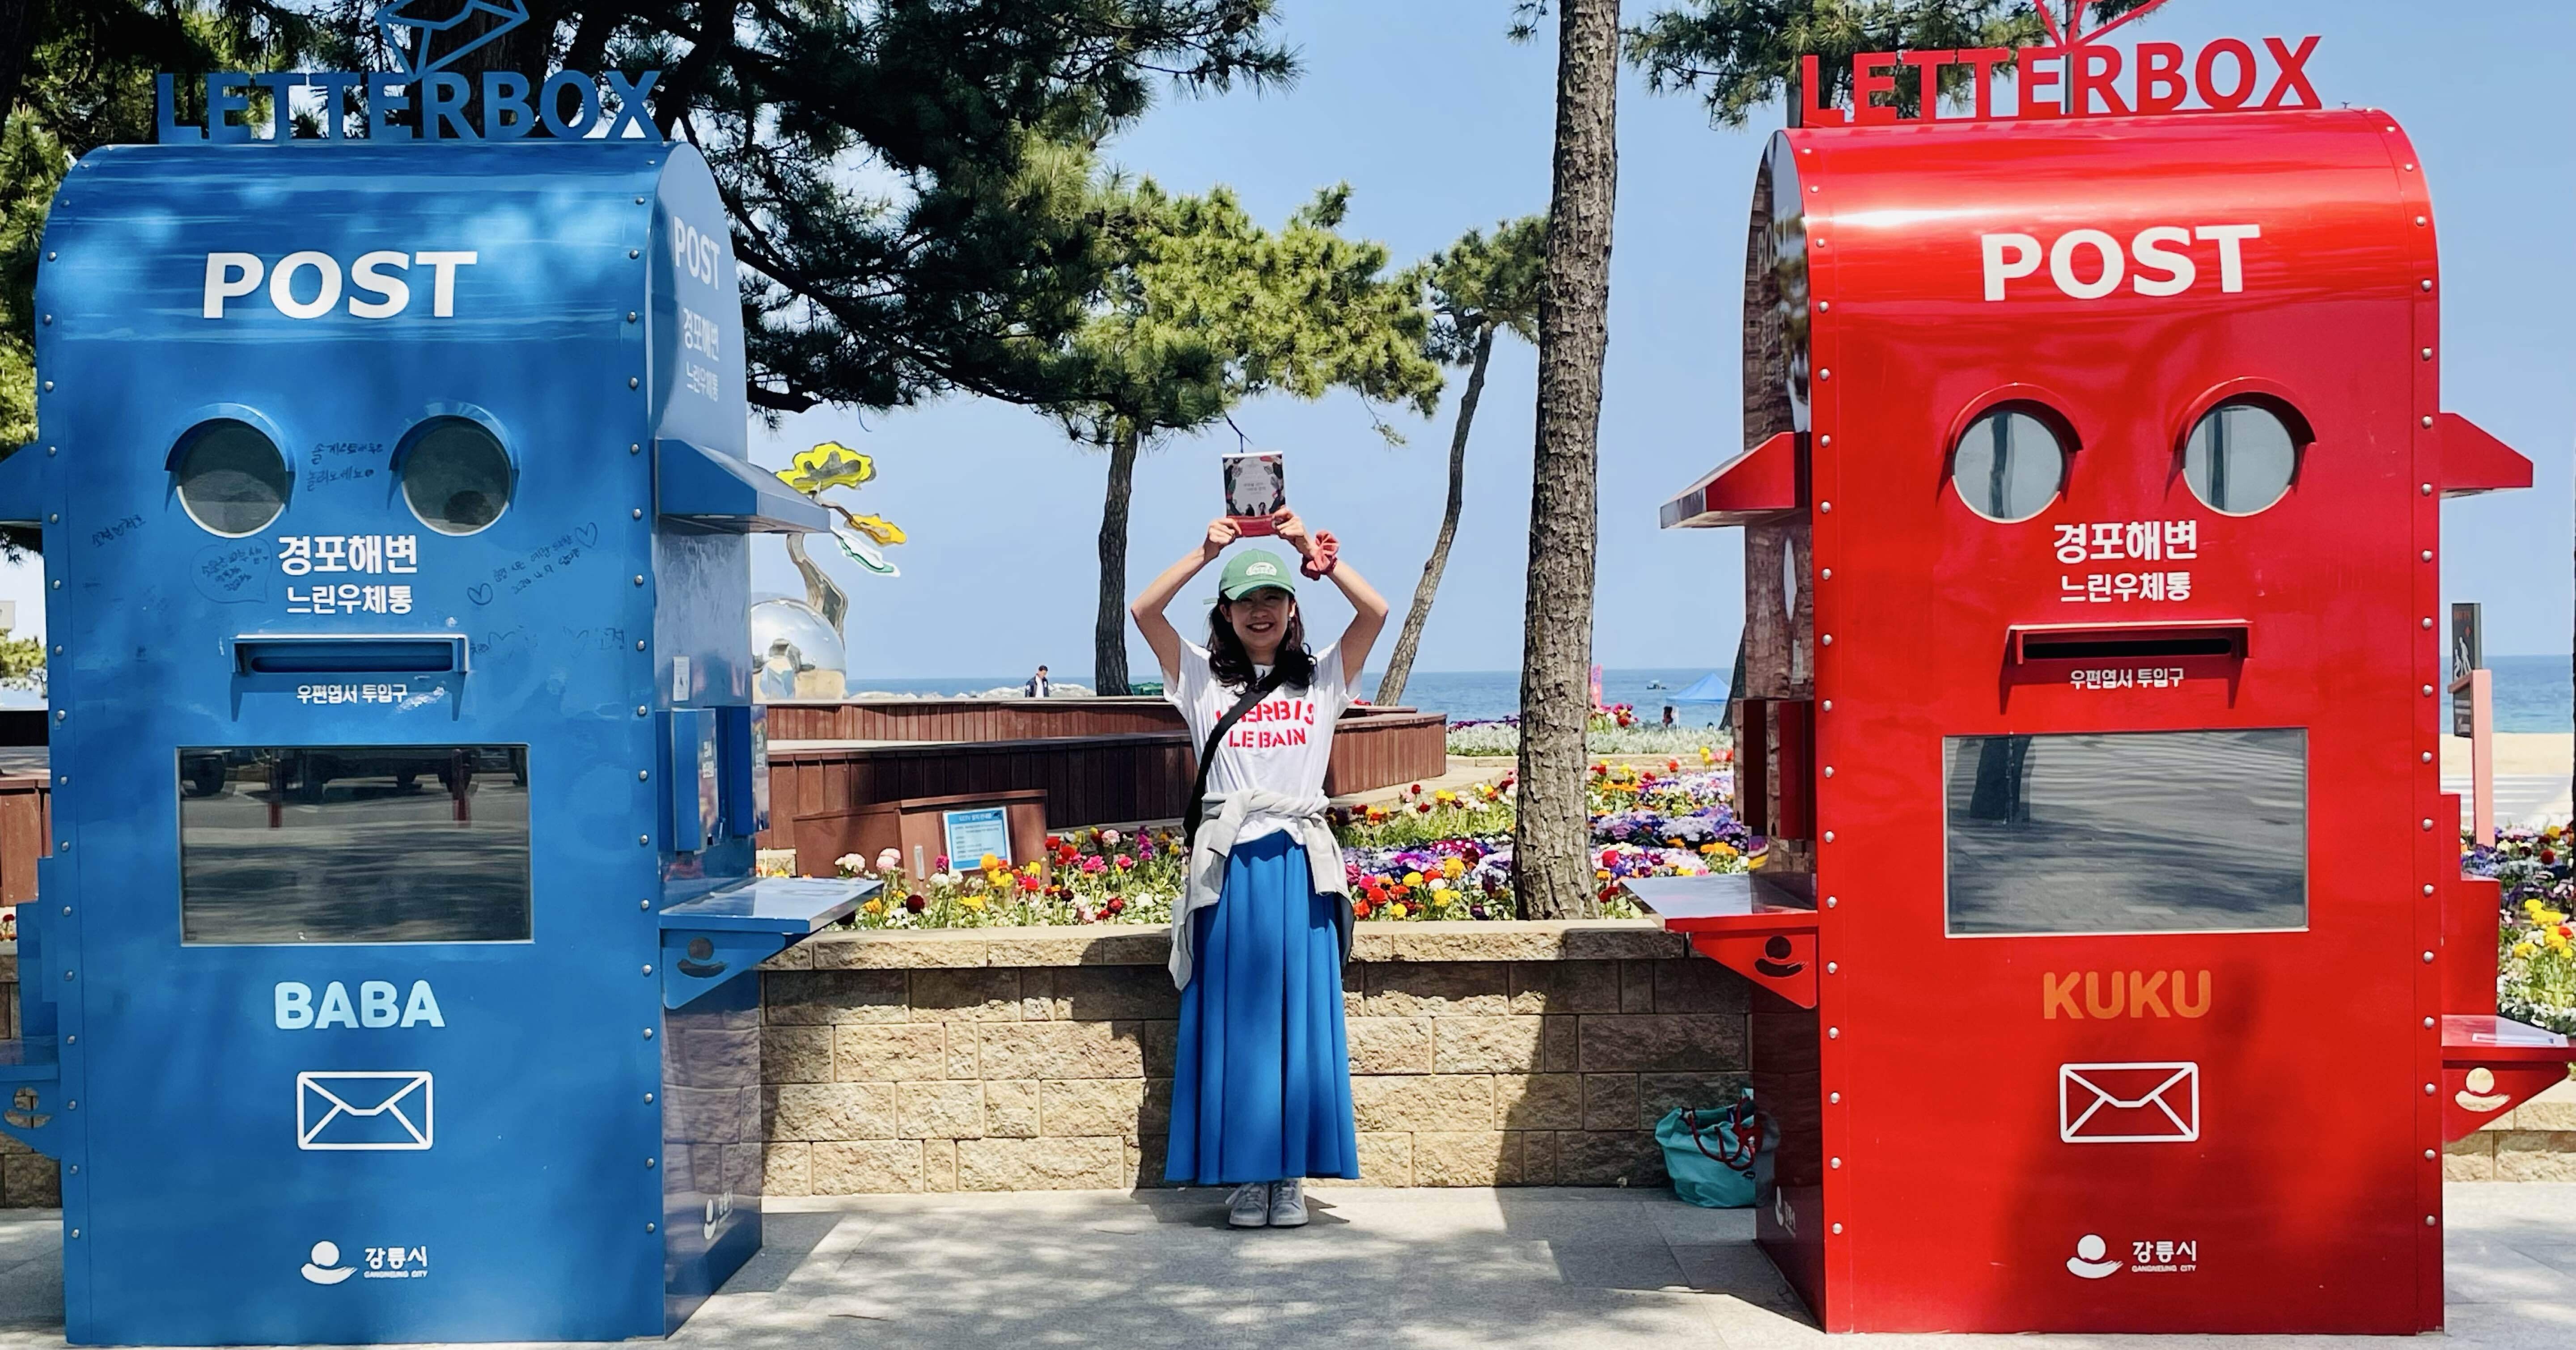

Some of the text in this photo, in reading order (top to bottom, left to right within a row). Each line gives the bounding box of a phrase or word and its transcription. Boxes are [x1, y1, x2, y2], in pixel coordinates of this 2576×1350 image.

[1802, 36, 2322, 127] LETTERBOX
[157, 70, 662, 142] LETTERBOX
[674, 216, 720, 290] POST
[1757, 205, 1789, 282] POST
[1981, 224, 2261, 301] POST
[203, 251, 478, 319] POST
[683, 307, 719, 362] 경포해변
[279, 535, 418, 576] 경포해변
[2054, 520, 2197, 564] 경포해변
[287, 584, 412, 614] 느린우체통
[2060, 571, 2191, 603] 느린우체통
[297, 684, 408, 704] 우편엽서 투입구
[2070, 668, 2184, 690] 우편엽서 투입구
[1229, 728, 1306, 748] LE BAIN
[275, 979, 445, 1029] BABA
[2043, 969, 2212, 1020] KUKU
[364, 1245, 428, 1270] 강릉시
[2132, 1240, 2197, 1264] 강릉시
